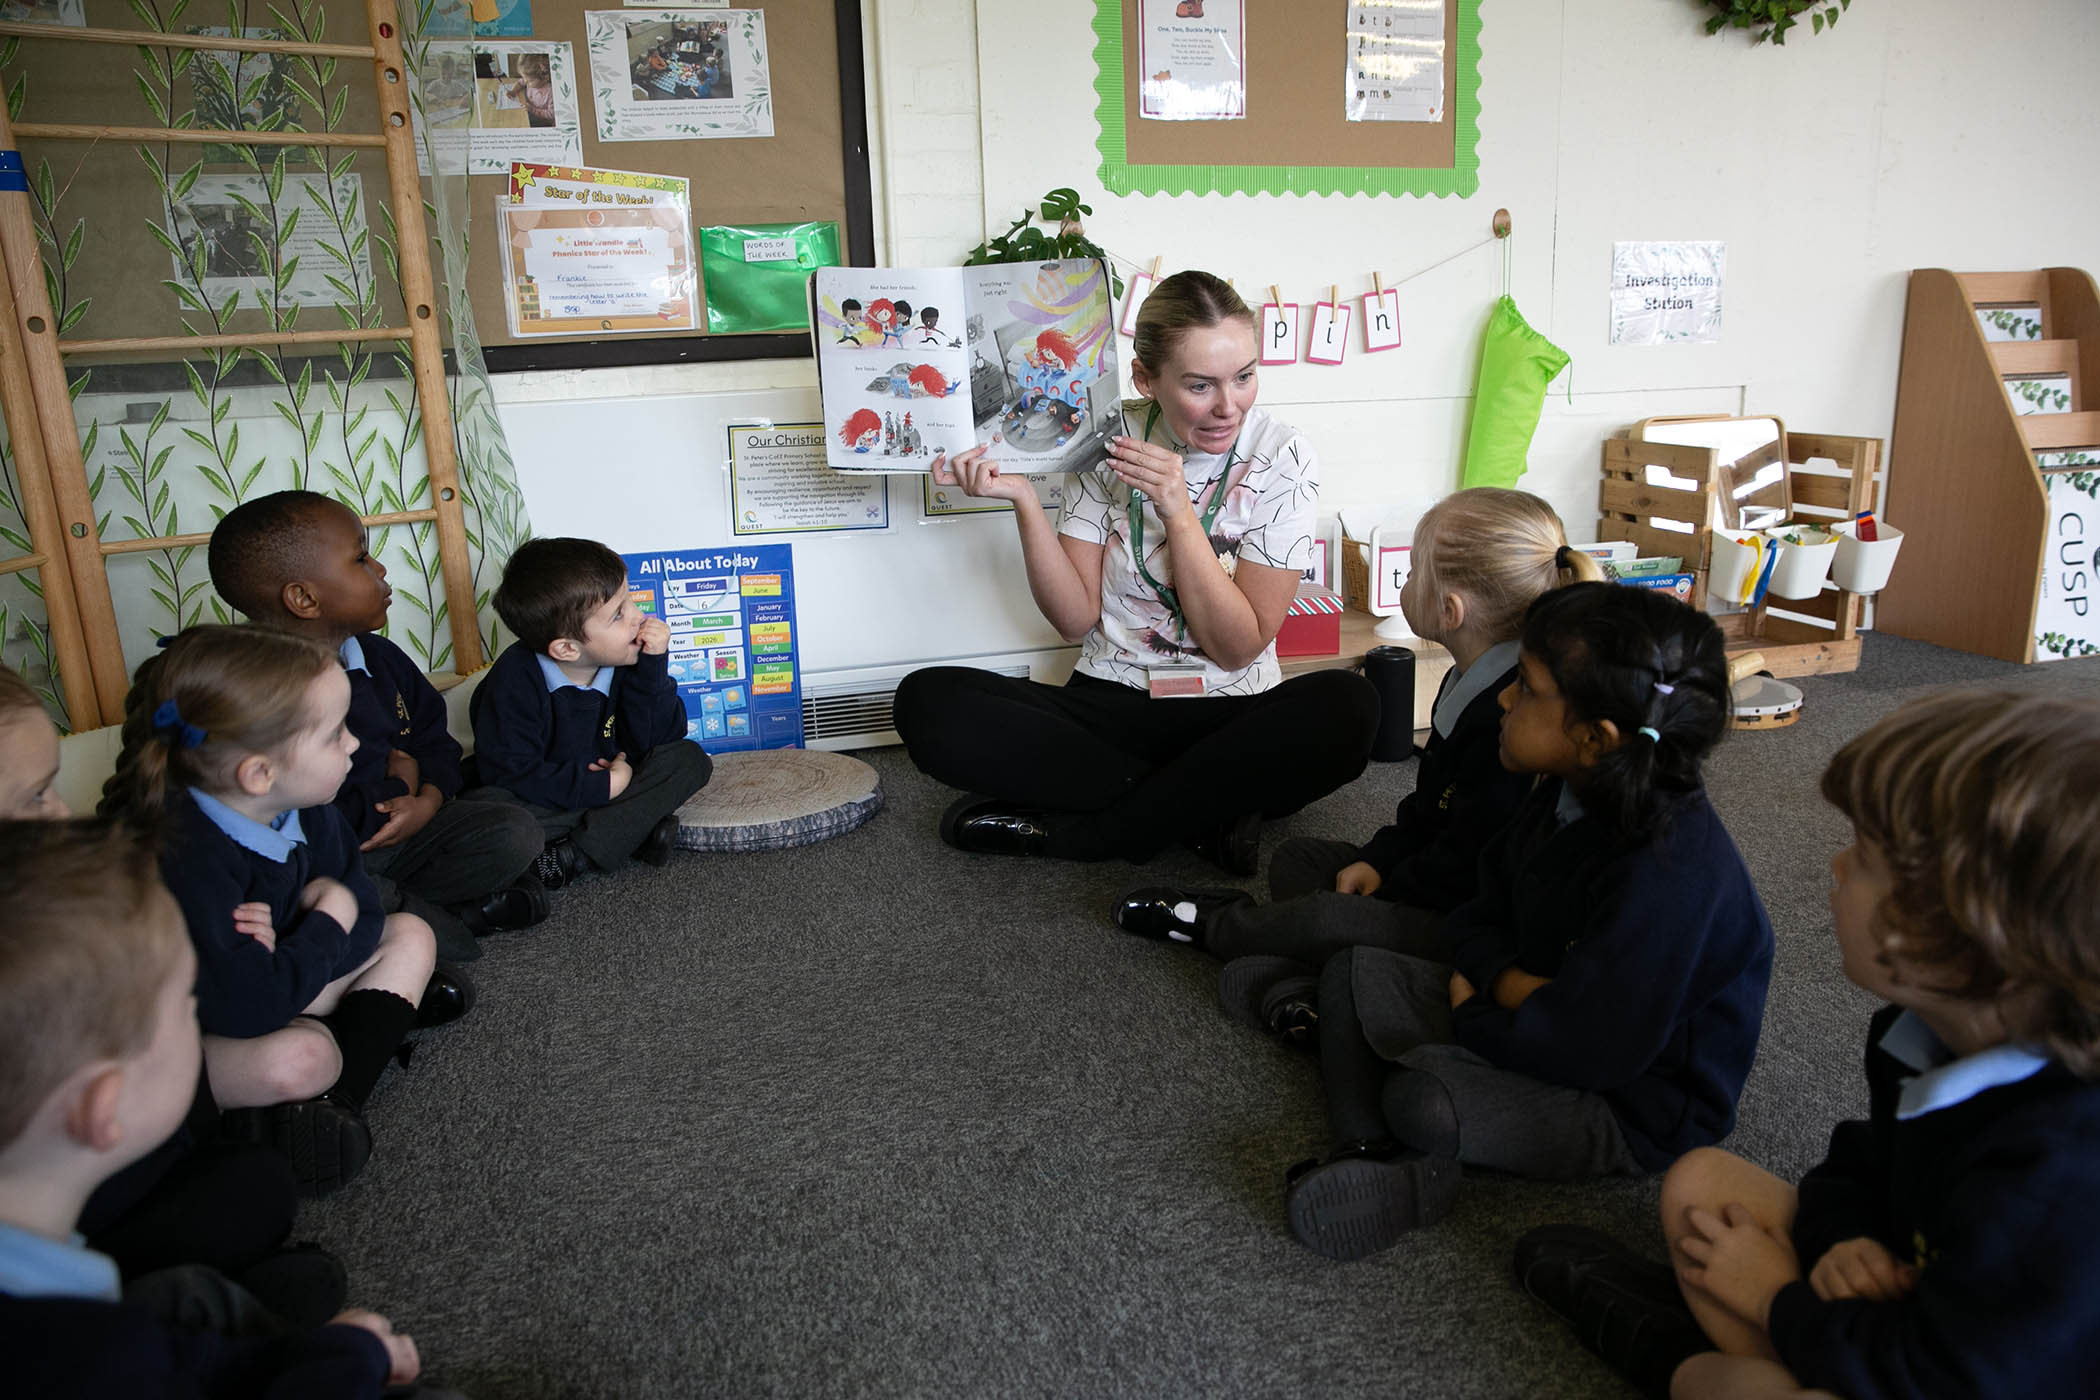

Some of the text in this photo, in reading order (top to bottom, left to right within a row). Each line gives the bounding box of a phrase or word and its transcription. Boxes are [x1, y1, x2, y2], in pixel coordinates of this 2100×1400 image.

[544, 186, 654, 205] Star of the Week!
[556, 274, 587, 282] Frankie
[1625, 273, 1714, 290] Investigation
[1644, 296, 1694, 310] Station
[1376, 312, 1390, 332] n
[1274, 320, 1288, 348] p
[1326, 320, 1334, 344] i
[748, 435, 772, 447] Our
[640, 554, 759, 574] All About Today
[2058, 512, 2088, 617] CUSP
[742, 576, 778, 586] September
[1393, 568, 1402, 590] t
[696, 582, 717, 590] Friday
[701, 601, 708, 610] 6
[756, 604, 782, 612] January
[670, 617, 723, 628] Month March
[755, 614, 784, 622] February
[763, 624, 776, 632] July
[756, 634, 783, 642] October
[763, 644, 779, 652] April
[674, 652, 700, 660] Weather
[757, 654, 789, 663] December
[766, 664, 780, 672] May
[760, 674, 784, 683] August
[754, 685, 788, 694] November
[771, 714, 787, 722] Years
